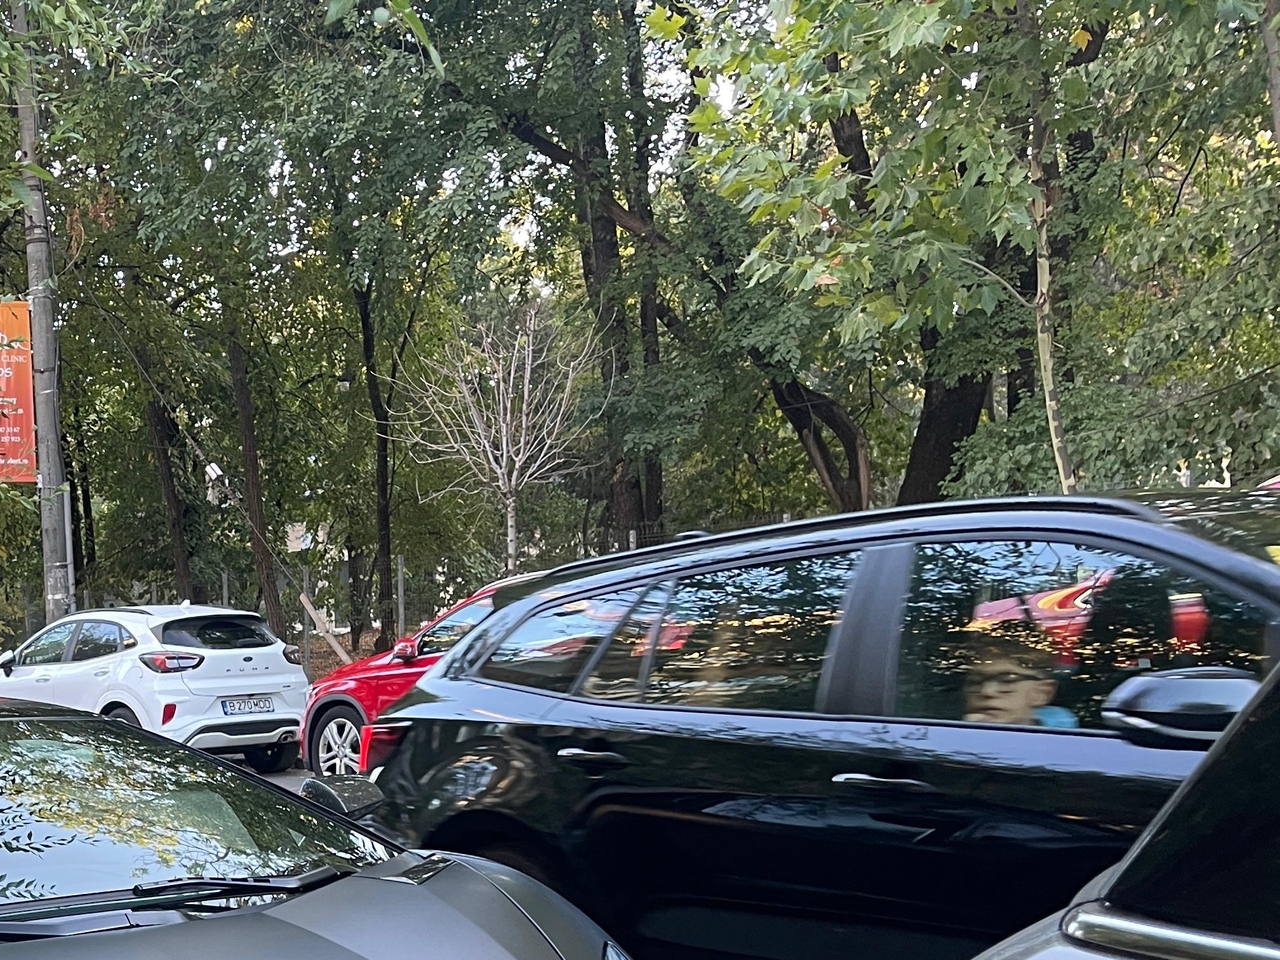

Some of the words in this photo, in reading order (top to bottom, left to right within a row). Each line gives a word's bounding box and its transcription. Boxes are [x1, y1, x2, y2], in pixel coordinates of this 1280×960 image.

[229, 701, 236, 711] B
[236, 700, 253, 711] 270
[253, 699, 271, 710] MOD
